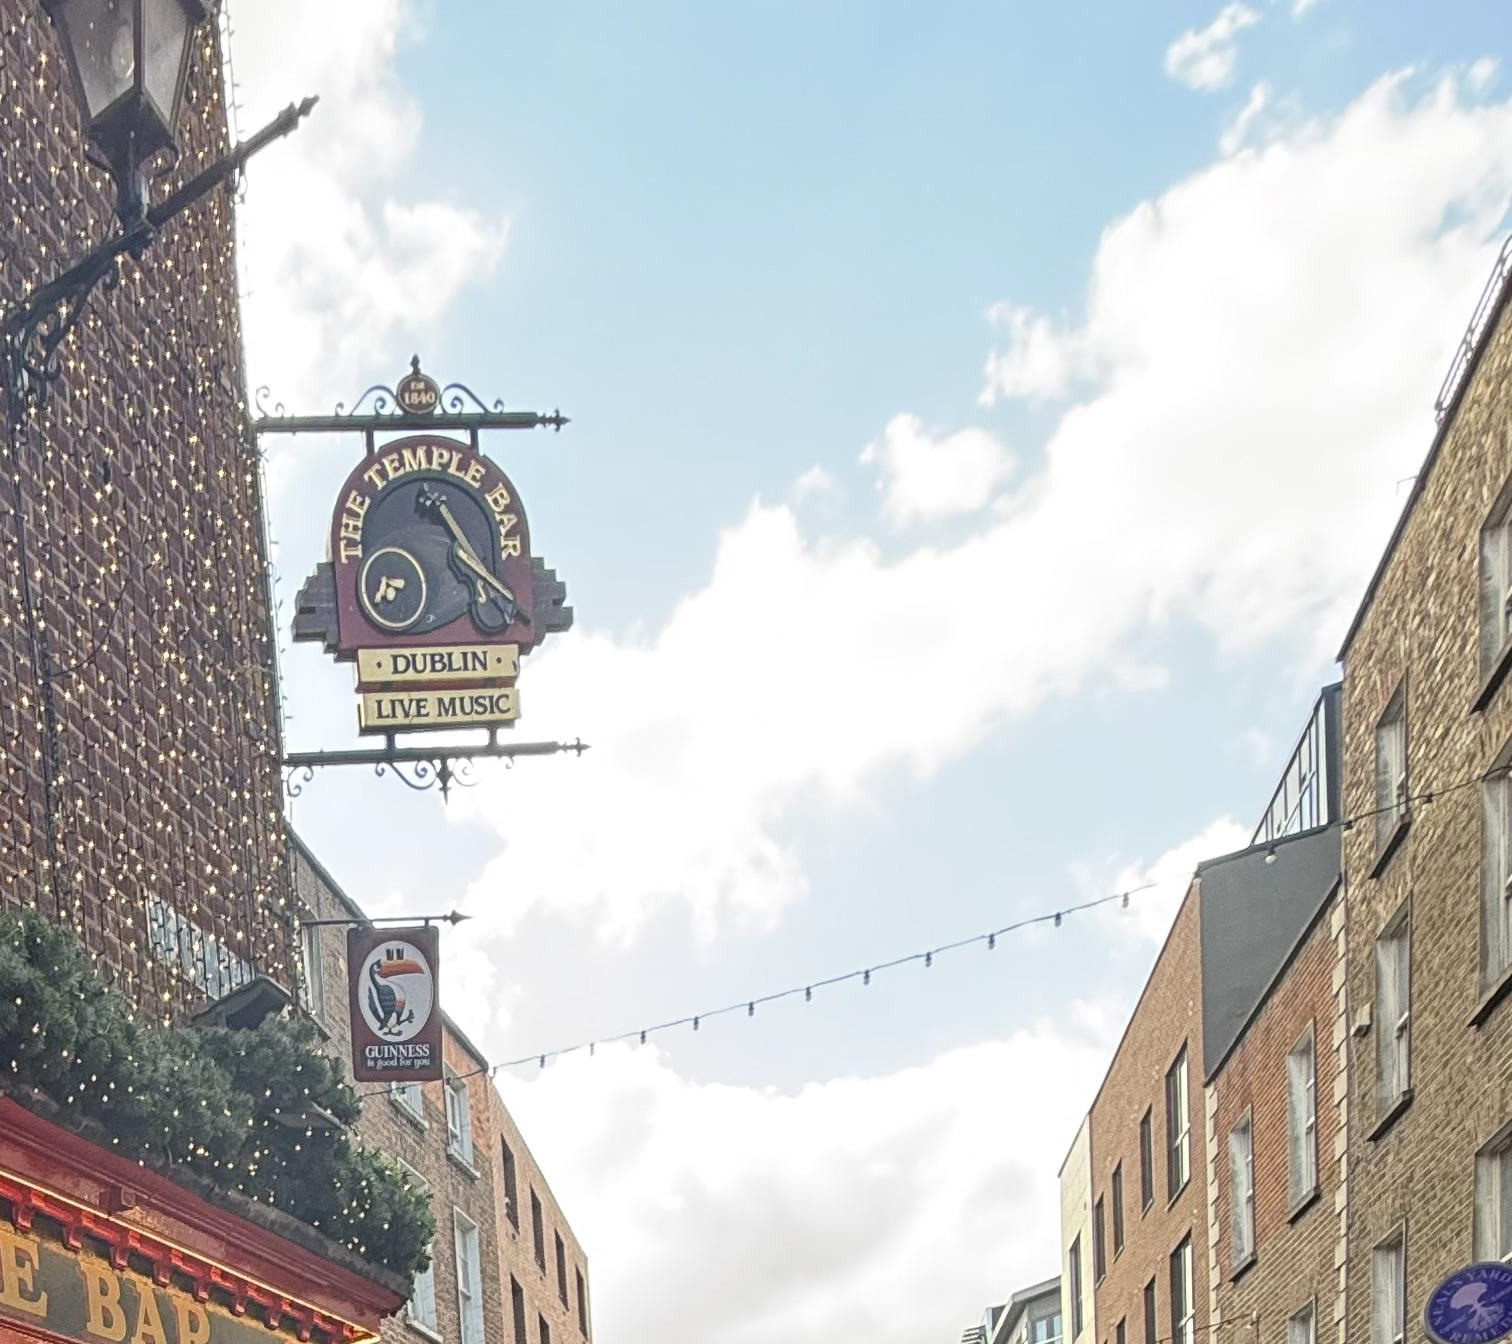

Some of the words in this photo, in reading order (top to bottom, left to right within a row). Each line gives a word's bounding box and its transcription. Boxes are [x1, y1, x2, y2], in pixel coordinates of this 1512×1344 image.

[404, 391, 435, 404] 1840
[340, 489, 371, 564] THE
[364, 445, 486, 492] TEMPLE
[484, 482, 520, 560] BAR
[391, 650, 488, 675] DUBLIN
[375, 697, 430, 719] LIVE
[436, 693, 511, 716] MUSIC
[365, 1044, 430, 1058] GUINNESS
[376, 1058, 398, 1070] good
